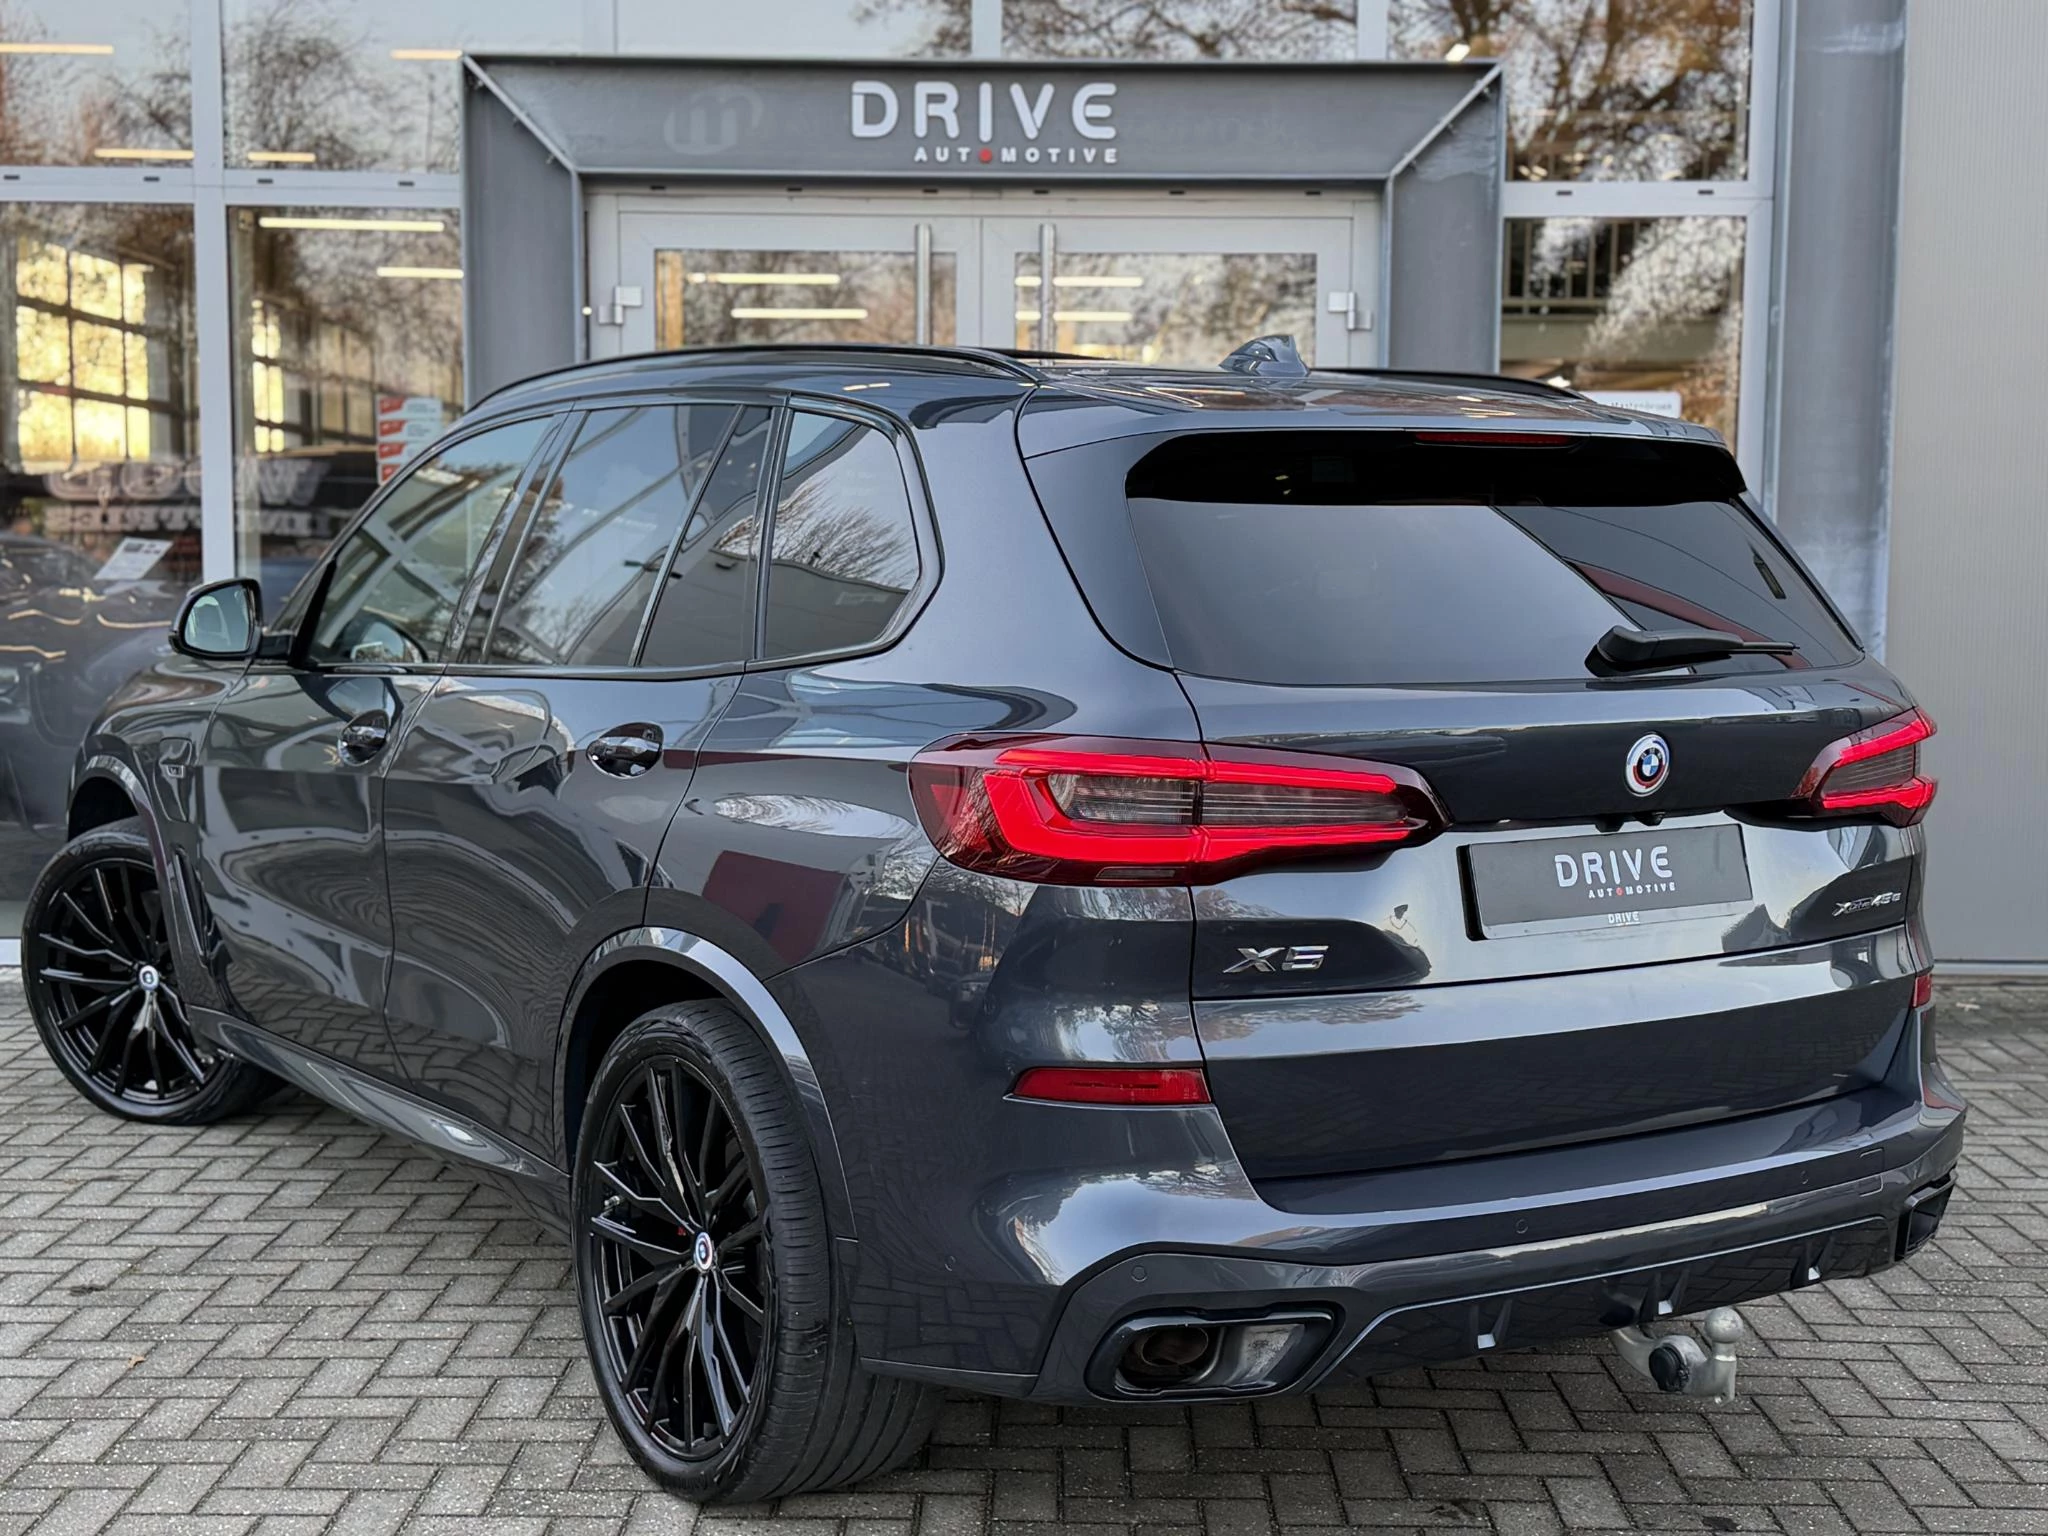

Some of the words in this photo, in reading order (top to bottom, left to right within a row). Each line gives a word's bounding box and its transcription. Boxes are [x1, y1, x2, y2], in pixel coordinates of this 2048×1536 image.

[851, 81, 1117, 142] DRIVE
[1554, 845, 1673, 887] DRIVE
[1588, 882, 1676, 899] AUTOMOTIVE
[1607, 911, 1640, 924] DRIVE
[1222, 945, 1329, 974] X5
